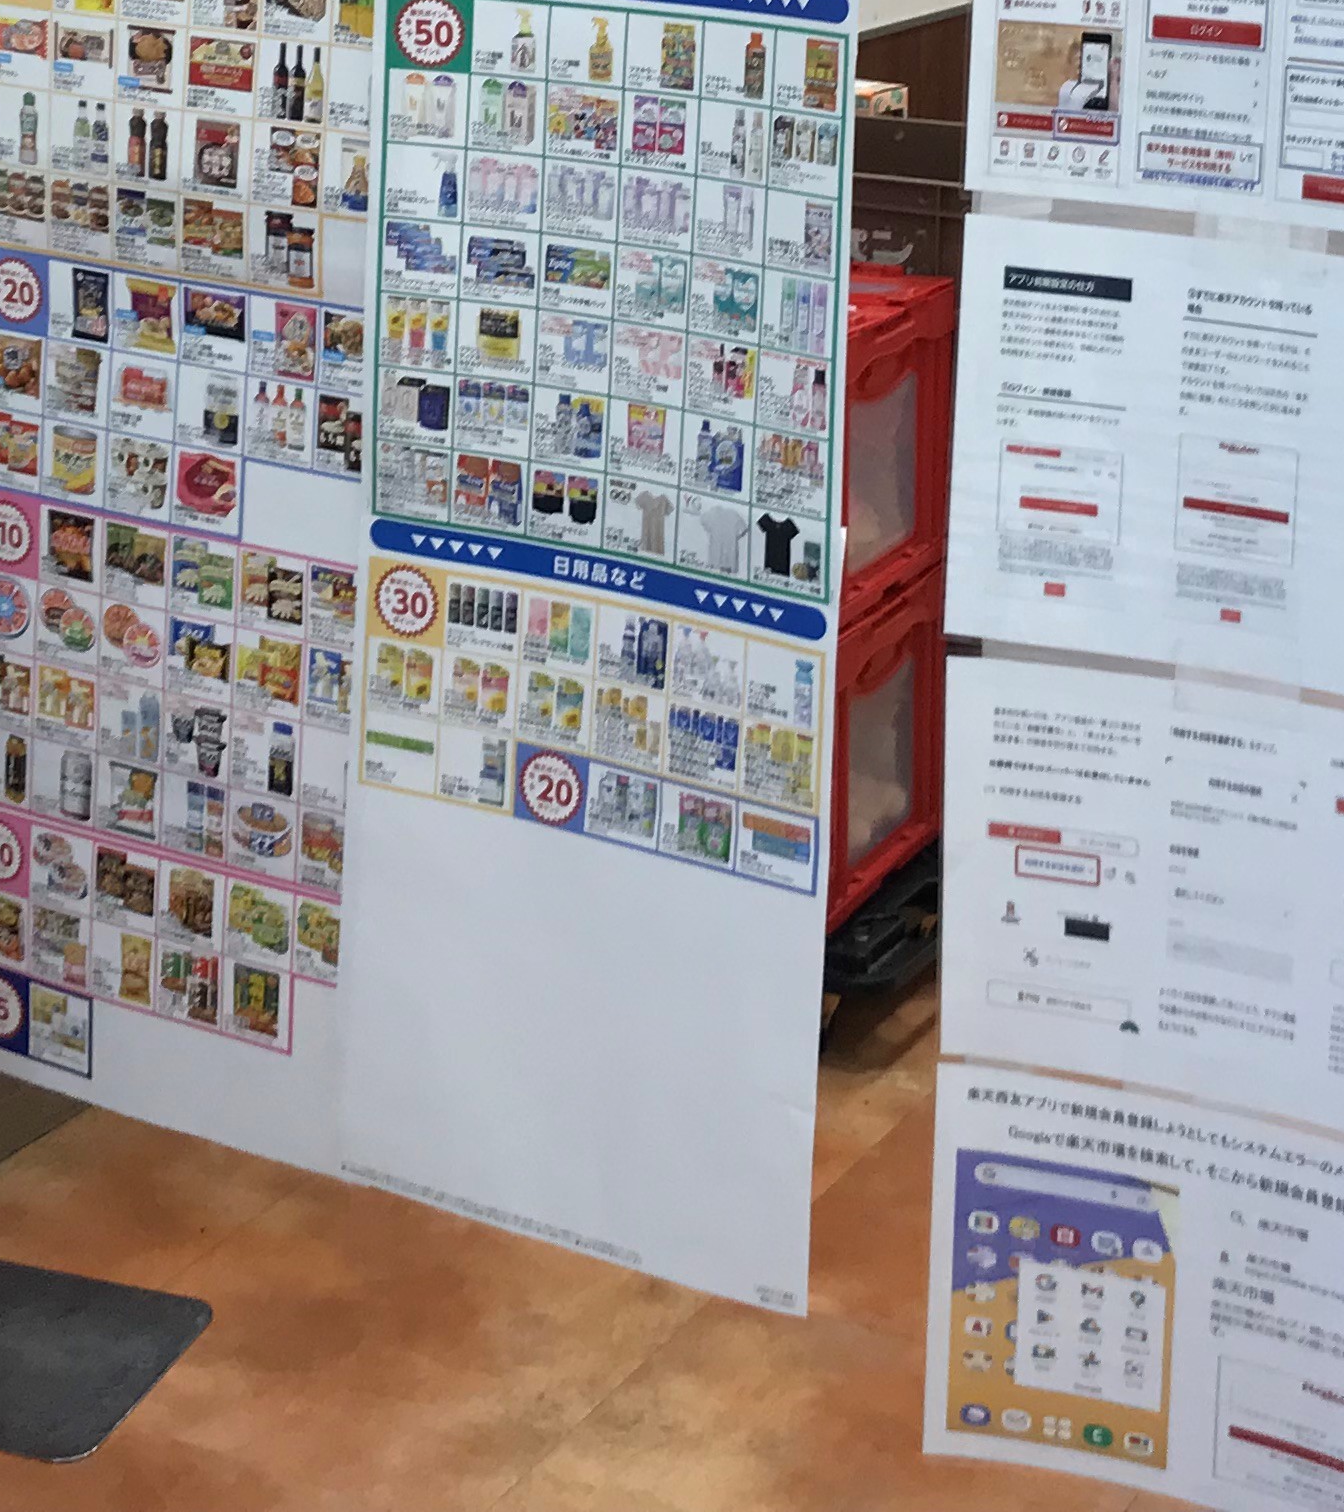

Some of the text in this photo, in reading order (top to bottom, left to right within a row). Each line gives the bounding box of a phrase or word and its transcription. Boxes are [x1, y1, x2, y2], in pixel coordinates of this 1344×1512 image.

[414, 19, 454, 48] 50
[3, 278, 35, 306] 20
[553, 555, 646, 591] 日用品など
[391, 589, 428, 619] 30
[537, 774, 573, 805] 20
